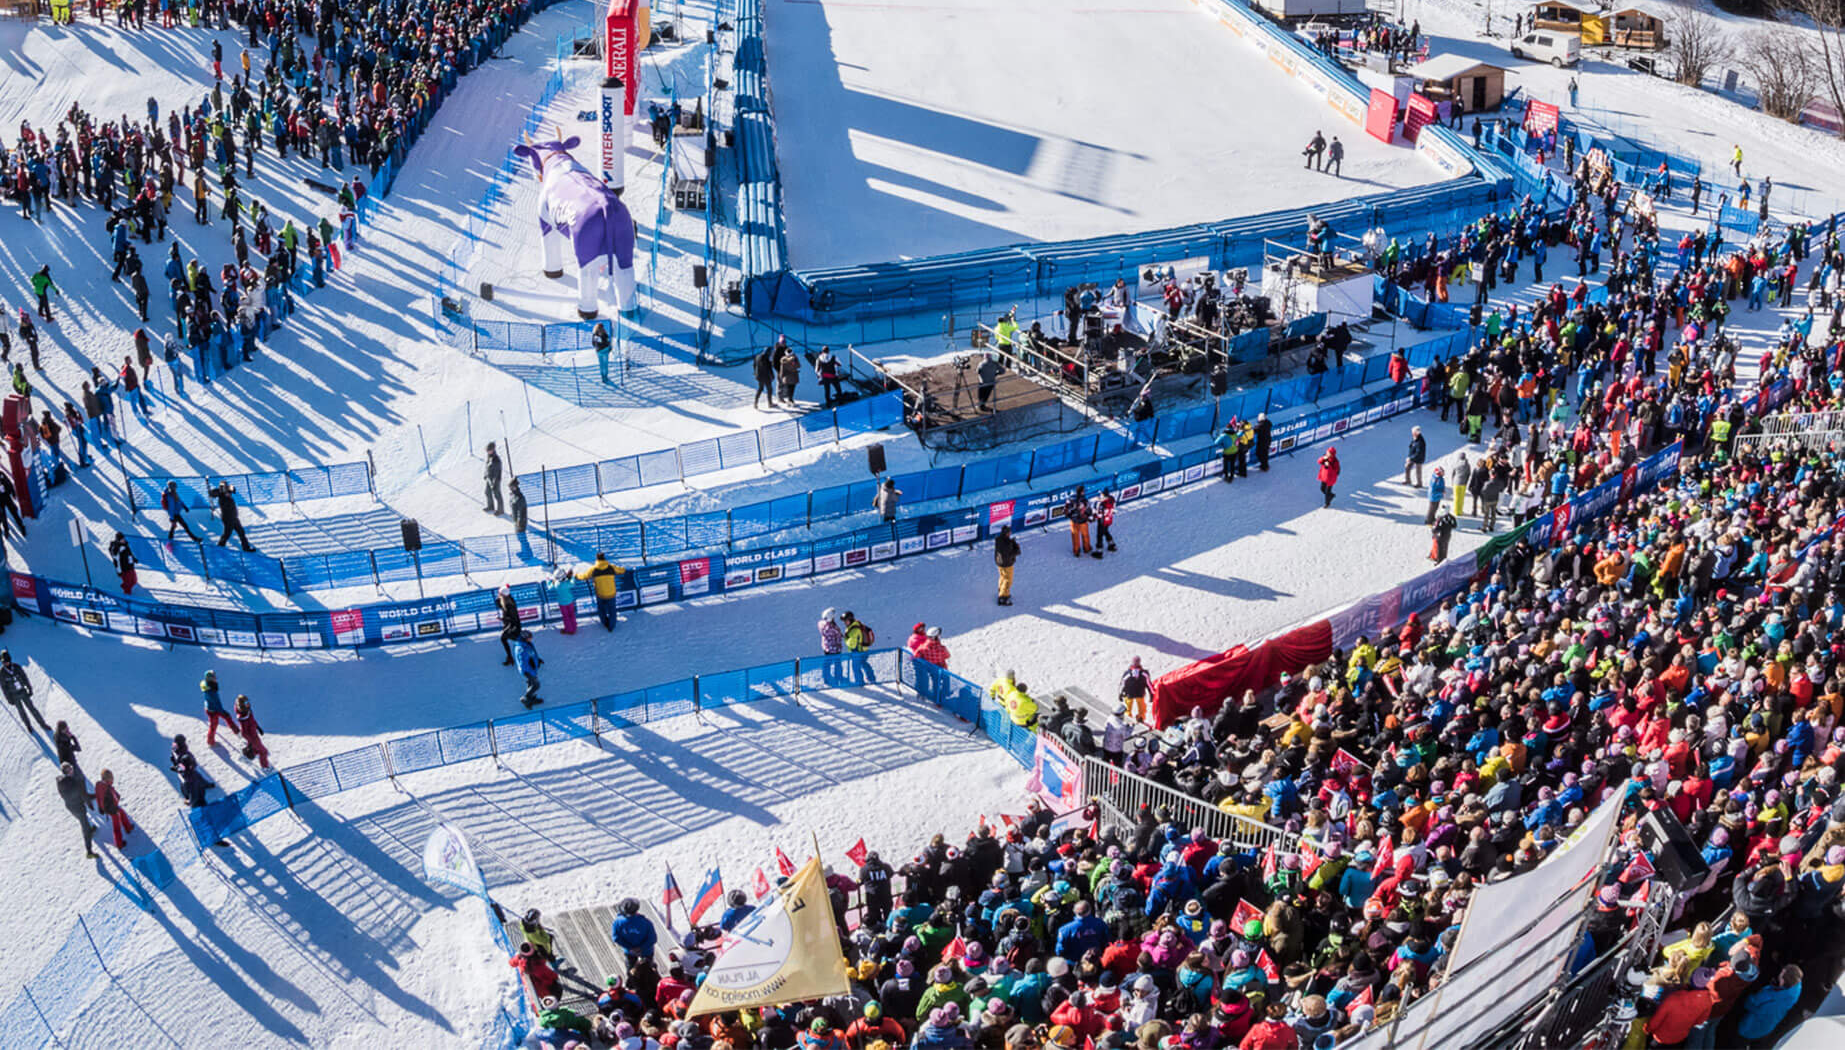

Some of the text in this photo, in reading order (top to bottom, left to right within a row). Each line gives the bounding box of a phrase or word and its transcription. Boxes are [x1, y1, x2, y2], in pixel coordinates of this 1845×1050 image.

[611, 27, 627, 86] NERALI
[602, 94, 614, 170] INTERSPORT
[1569, 485, 1620, 524] Kronplatz
[725, 547, 798, 567] WORLD CLASS
[48, 587, 84, 600] WORLD
[85, 592, 117, 606] CLASS
[378, 607, 419, 620] WORLD
